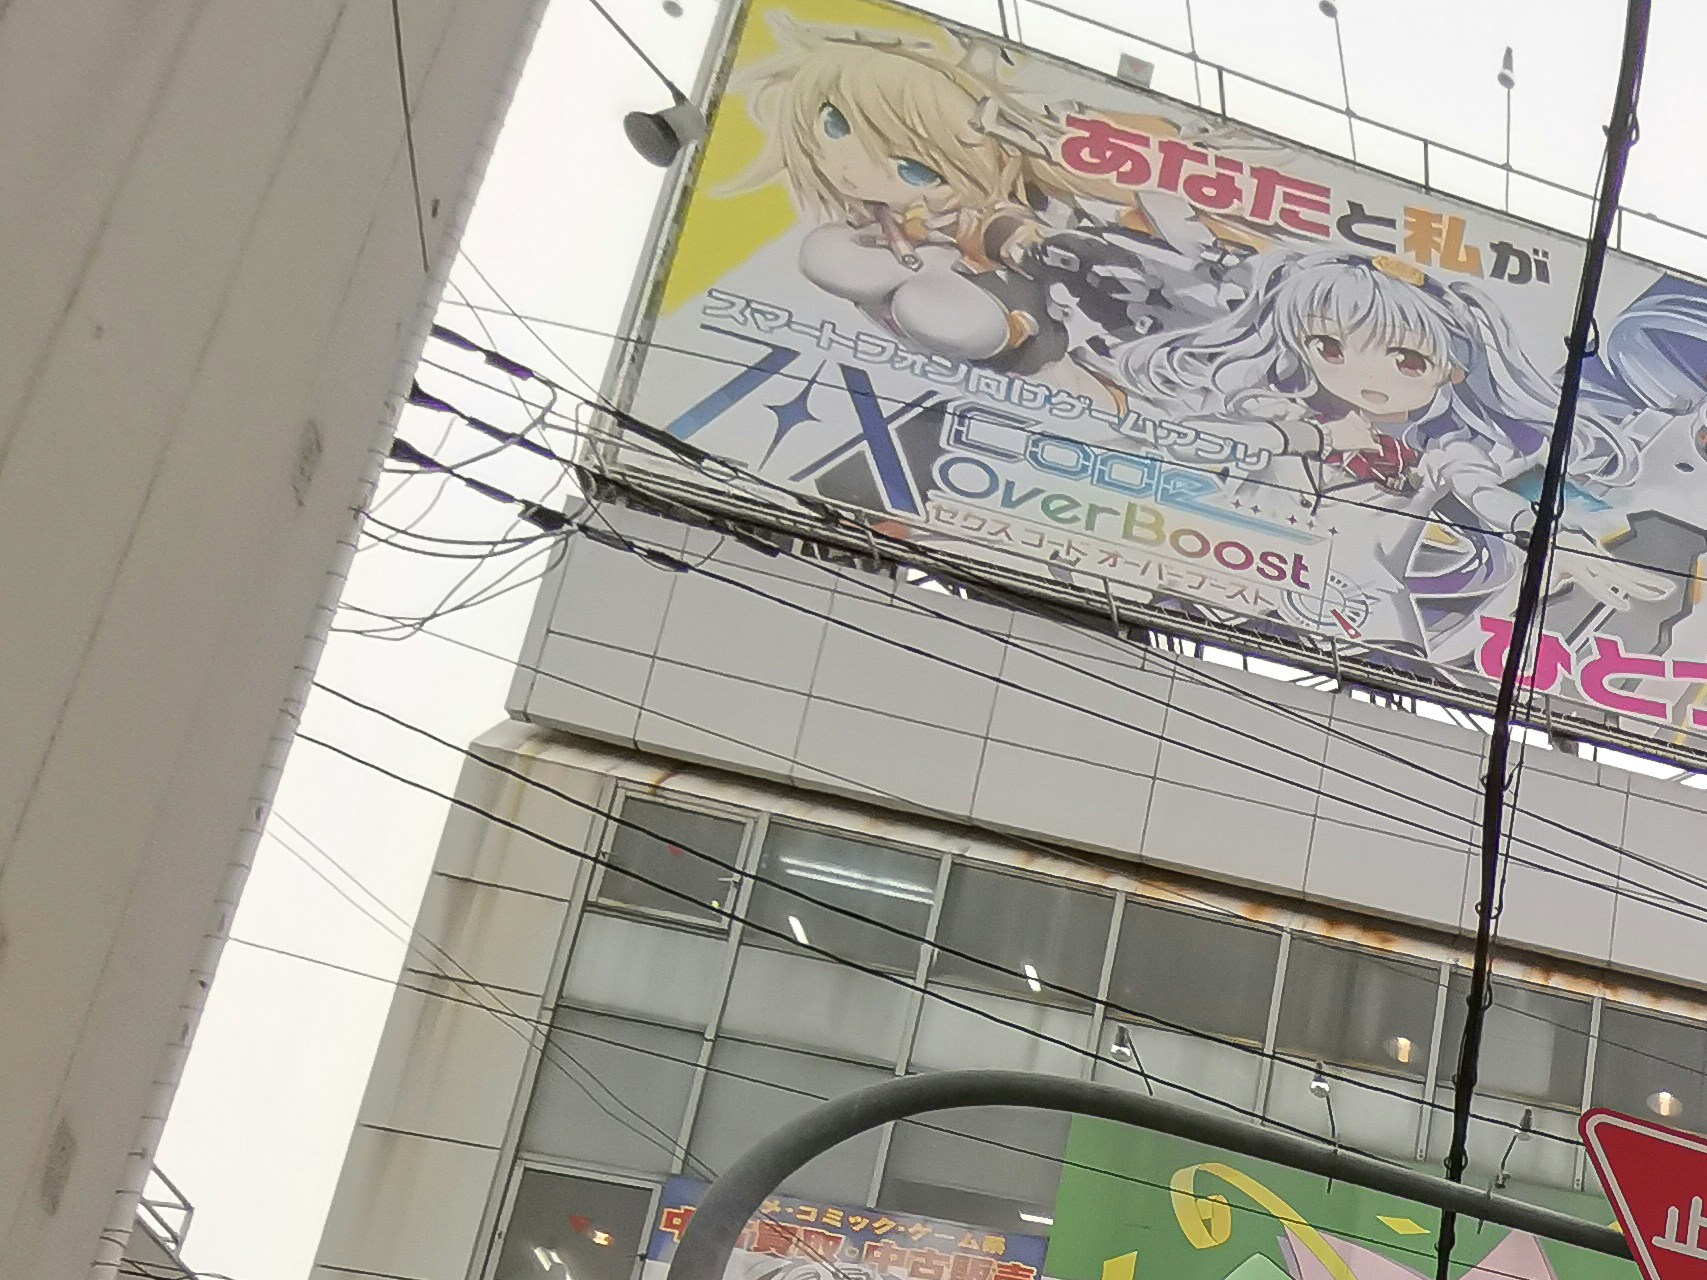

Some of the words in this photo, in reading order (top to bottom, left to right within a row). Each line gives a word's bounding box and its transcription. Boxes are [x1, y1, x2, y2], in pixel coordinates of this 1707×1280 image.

[1061, 114, 1552, 287] あなたと私が
[702, 287, 1274, 472] スマートフォン向けゲームアプリ
